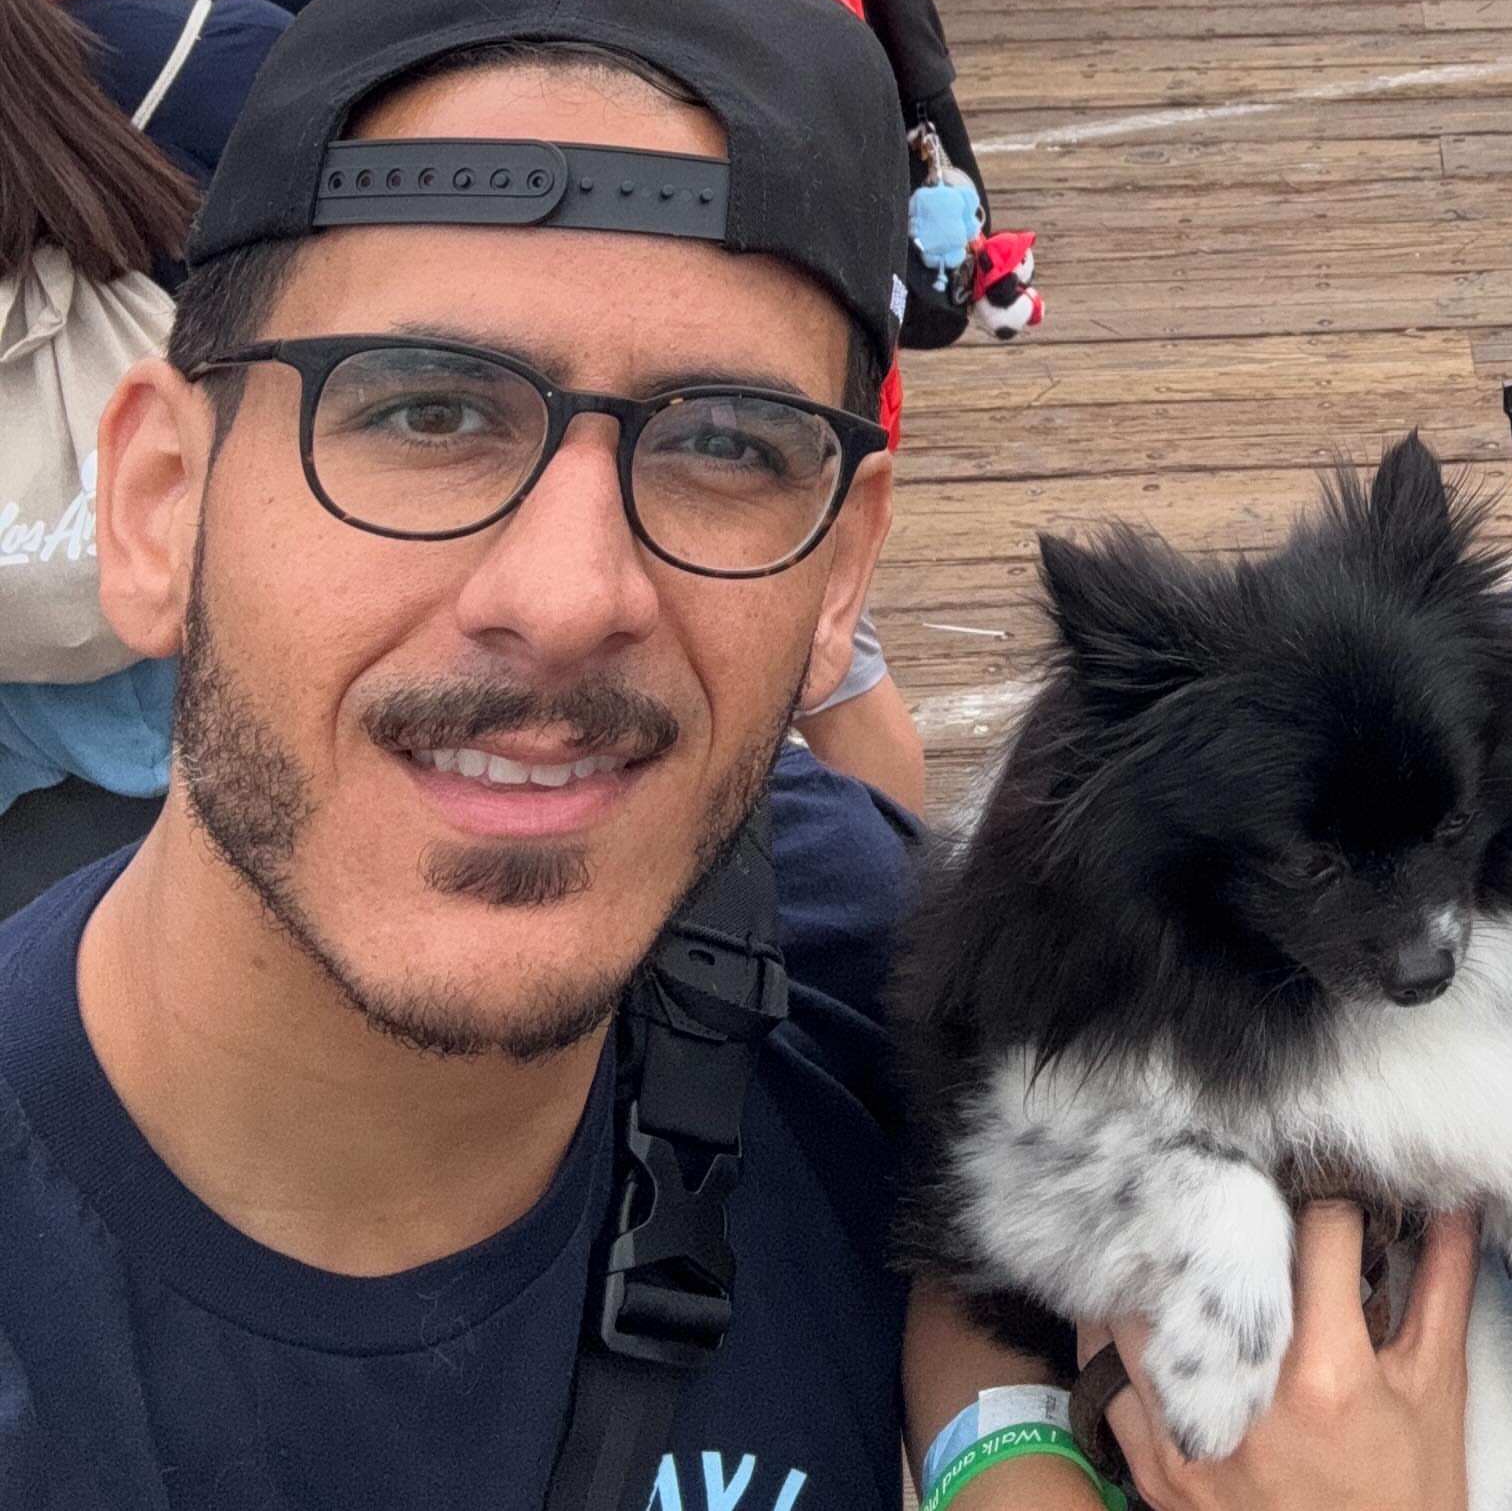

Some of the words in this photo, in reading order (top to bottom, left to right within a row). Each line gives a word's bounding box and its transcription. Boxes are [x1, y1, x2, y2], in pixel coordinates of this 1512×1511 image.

[981, 1428, 1042, 1456] Walk
[1051, 1429, 1058, 1443] I
[941, 1451, 976, 1495] and
